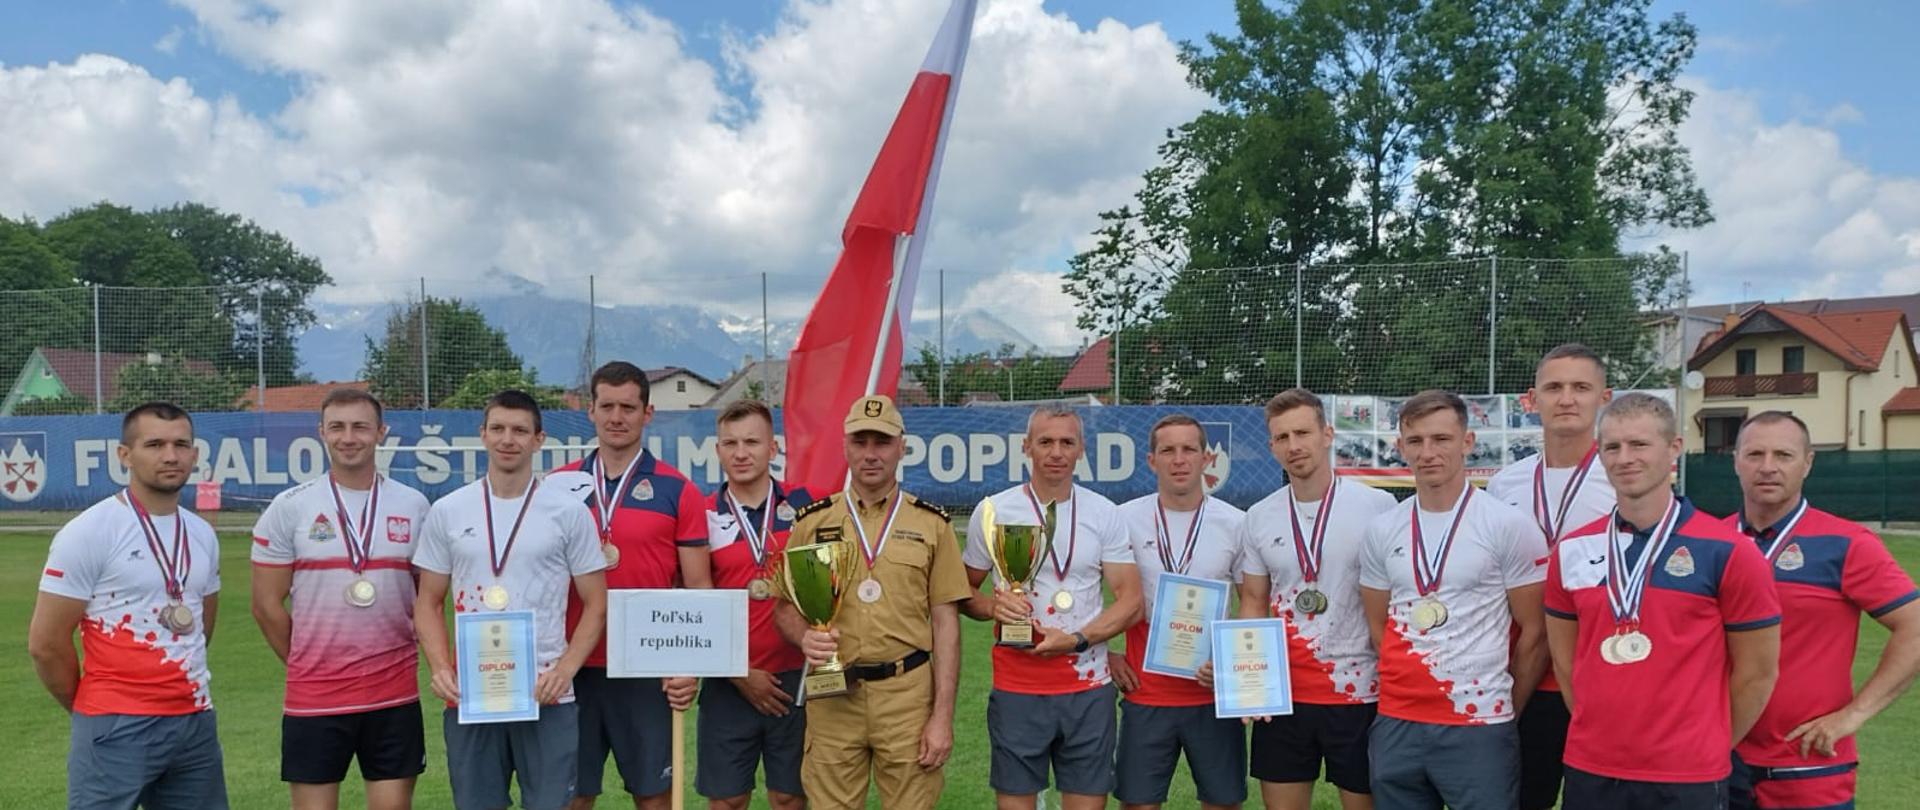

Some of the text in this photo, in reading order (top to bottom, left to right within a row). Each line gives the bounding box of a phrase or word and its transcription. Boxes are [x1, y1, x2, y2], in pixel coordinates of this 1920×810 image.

[651, 610, 703, 624] Poľská
[1169, 621, 1204, 634] DIPLOM
[640, 635, 712, 651] republika
[478, 662, 516, 672] DIPLOM
[1233, 663, 1269, 673] DIPLOM
